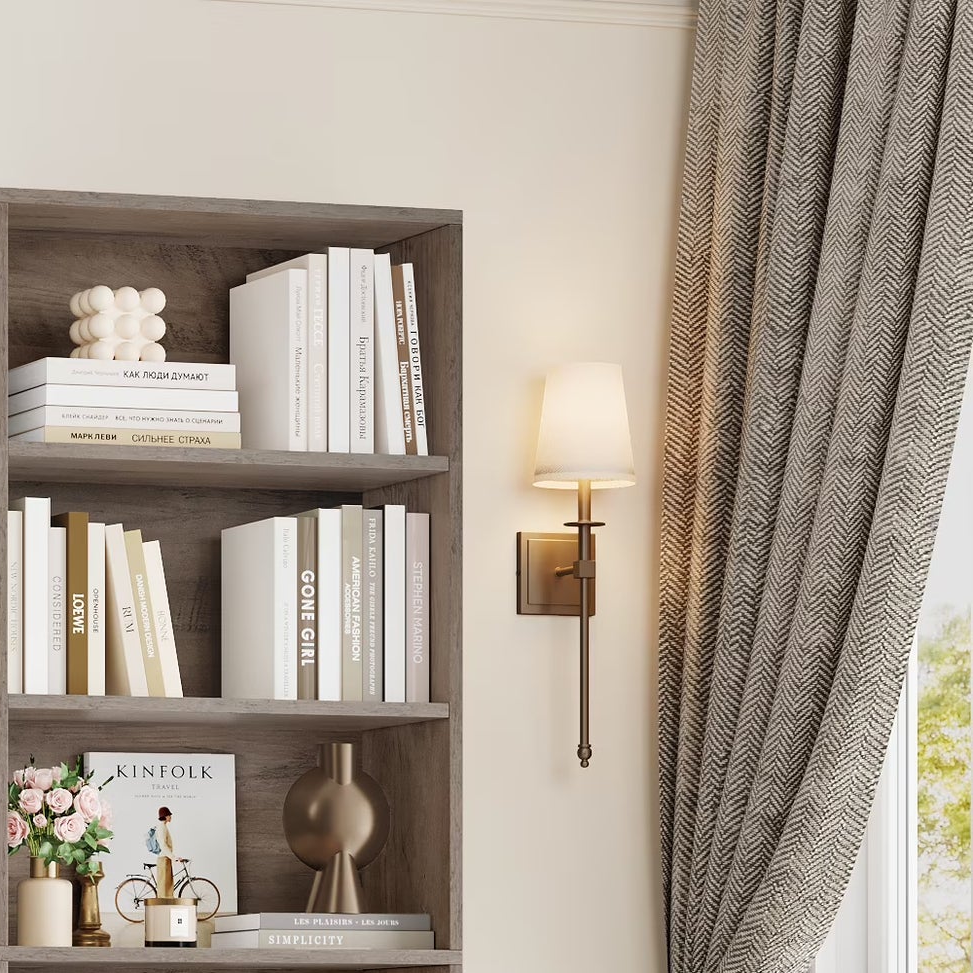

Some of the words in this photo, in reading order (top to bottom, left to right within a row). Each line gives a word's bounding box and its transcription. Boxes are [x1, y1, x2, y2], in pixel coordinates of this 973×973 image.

[294, 346, 303, 394] Маленькие
[356, 336, 369, 373] Братья
[409, 330, 421, 381] ГОВОРИ
[123, 371, 140, 379] КАК
[142, 371, 169, 380] ЛЮДИ
[171, 373, 209, 381] ДУМАЮТ
[356, 376, 369, 440] Карамазовы
[414, 384, 424, 406] КАК
[294, 395, 302, 438] женщины
[416, 409, 425, 428] БОГ
[70, 432, 94, 440] МАРК
[94, 433, 117, 441] ЛЕВИ
[131, 434, 174, 444] СИЛЬНЕЕ
[178, 435, 211, 445] СТРАХА
[368, 518, 376, 545] FRIDA
[368, 546, 376, 578] KAHLO
[135, 574, 146, 600] DANISH
[301, 570, 315, 621] GONE
[351, 556, 361, 613] AMERICAN
[413, 561, 423, 614] STEPHEN
[52, 576, 62, 651] CONSIDERED
[72, 593, 85, 634] LOEWE
[122, 606, 134, 633] RUM
[139, 601, 151, 632] MODERN
[144, 633, 155, 658] DESIGN
[301, 628, 315, 666] GIRL
[351, 615, 361, 662] FASHION
[413, 617, 423, 664] MARINO
[117, 765, 213, 779] KINFOLK
[313, 918, 353, 926] PLAISIRS
[268, 935, 344, 946] SIMPLICITY
